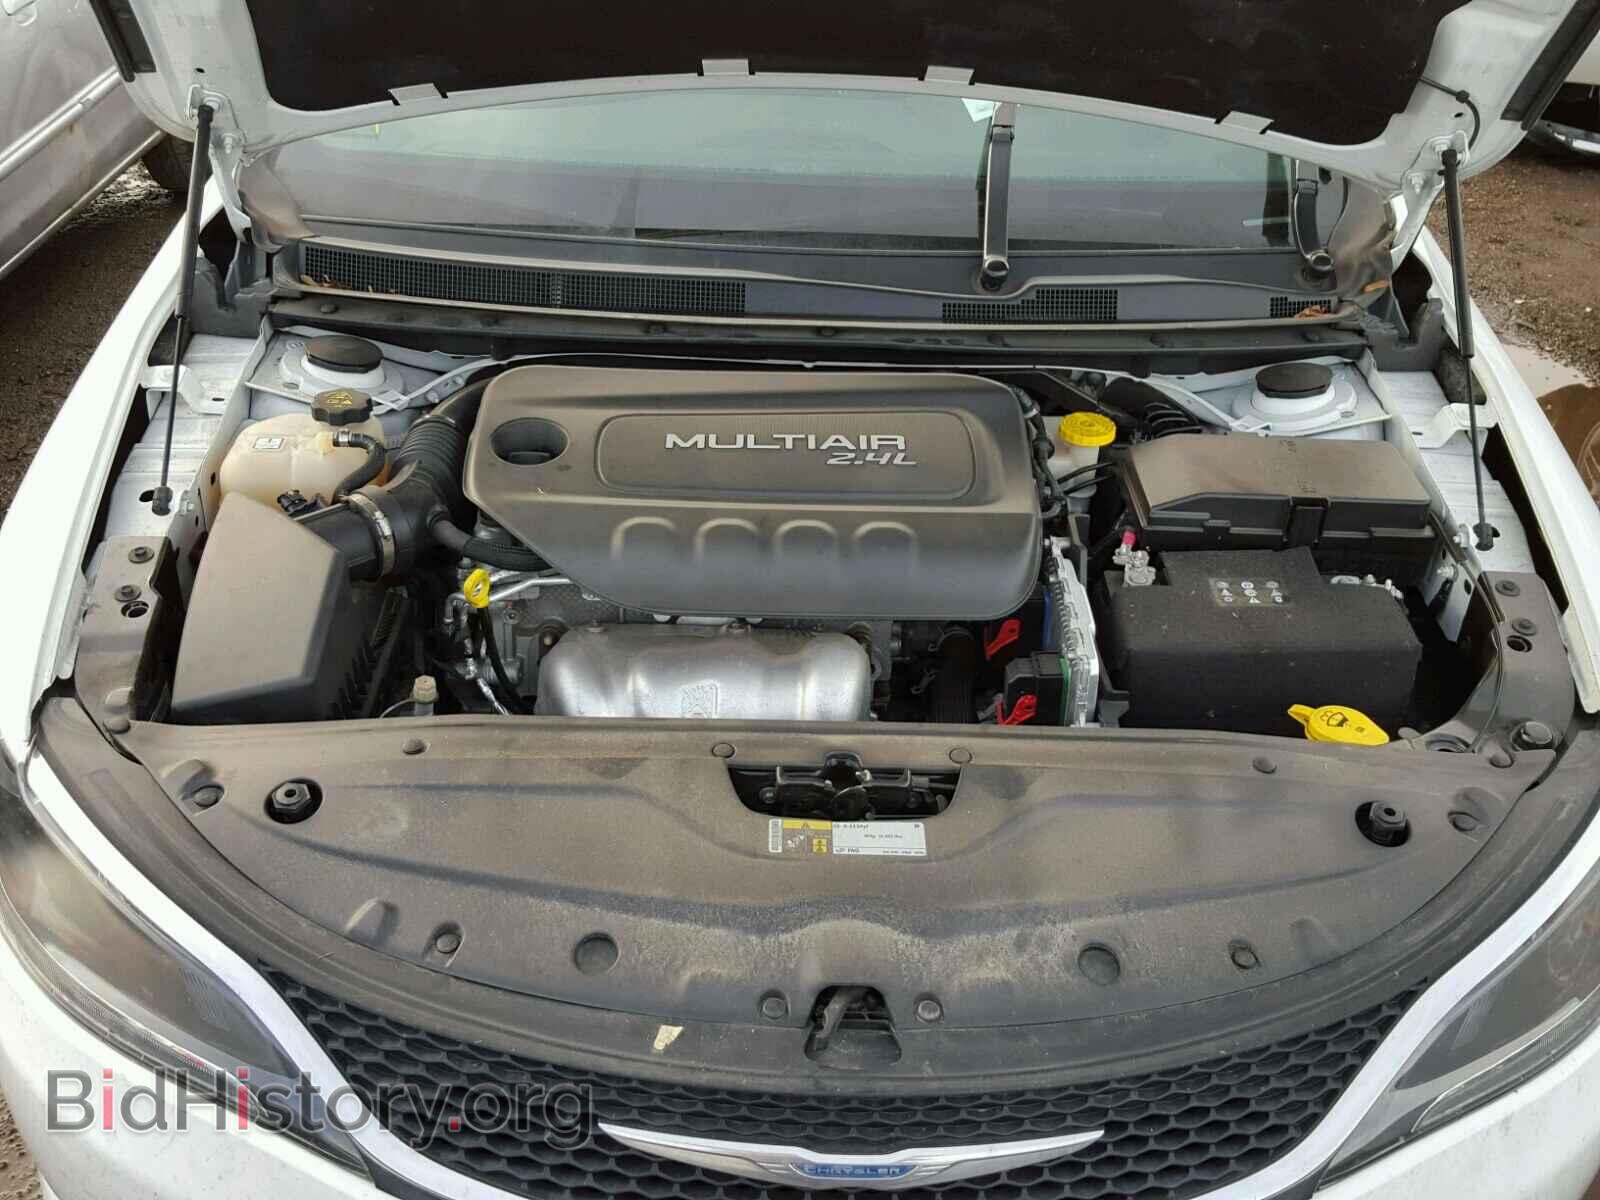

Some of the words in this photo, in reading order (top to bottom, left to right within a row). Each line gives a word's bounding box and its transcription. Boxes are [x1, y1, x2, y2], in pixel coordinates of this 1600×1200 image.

[665, 434, 906, 450] MULTIAIR
[826, 452, 917, 465] 2.4L
[803, 1164, 901, 1176] CHRYSLER
